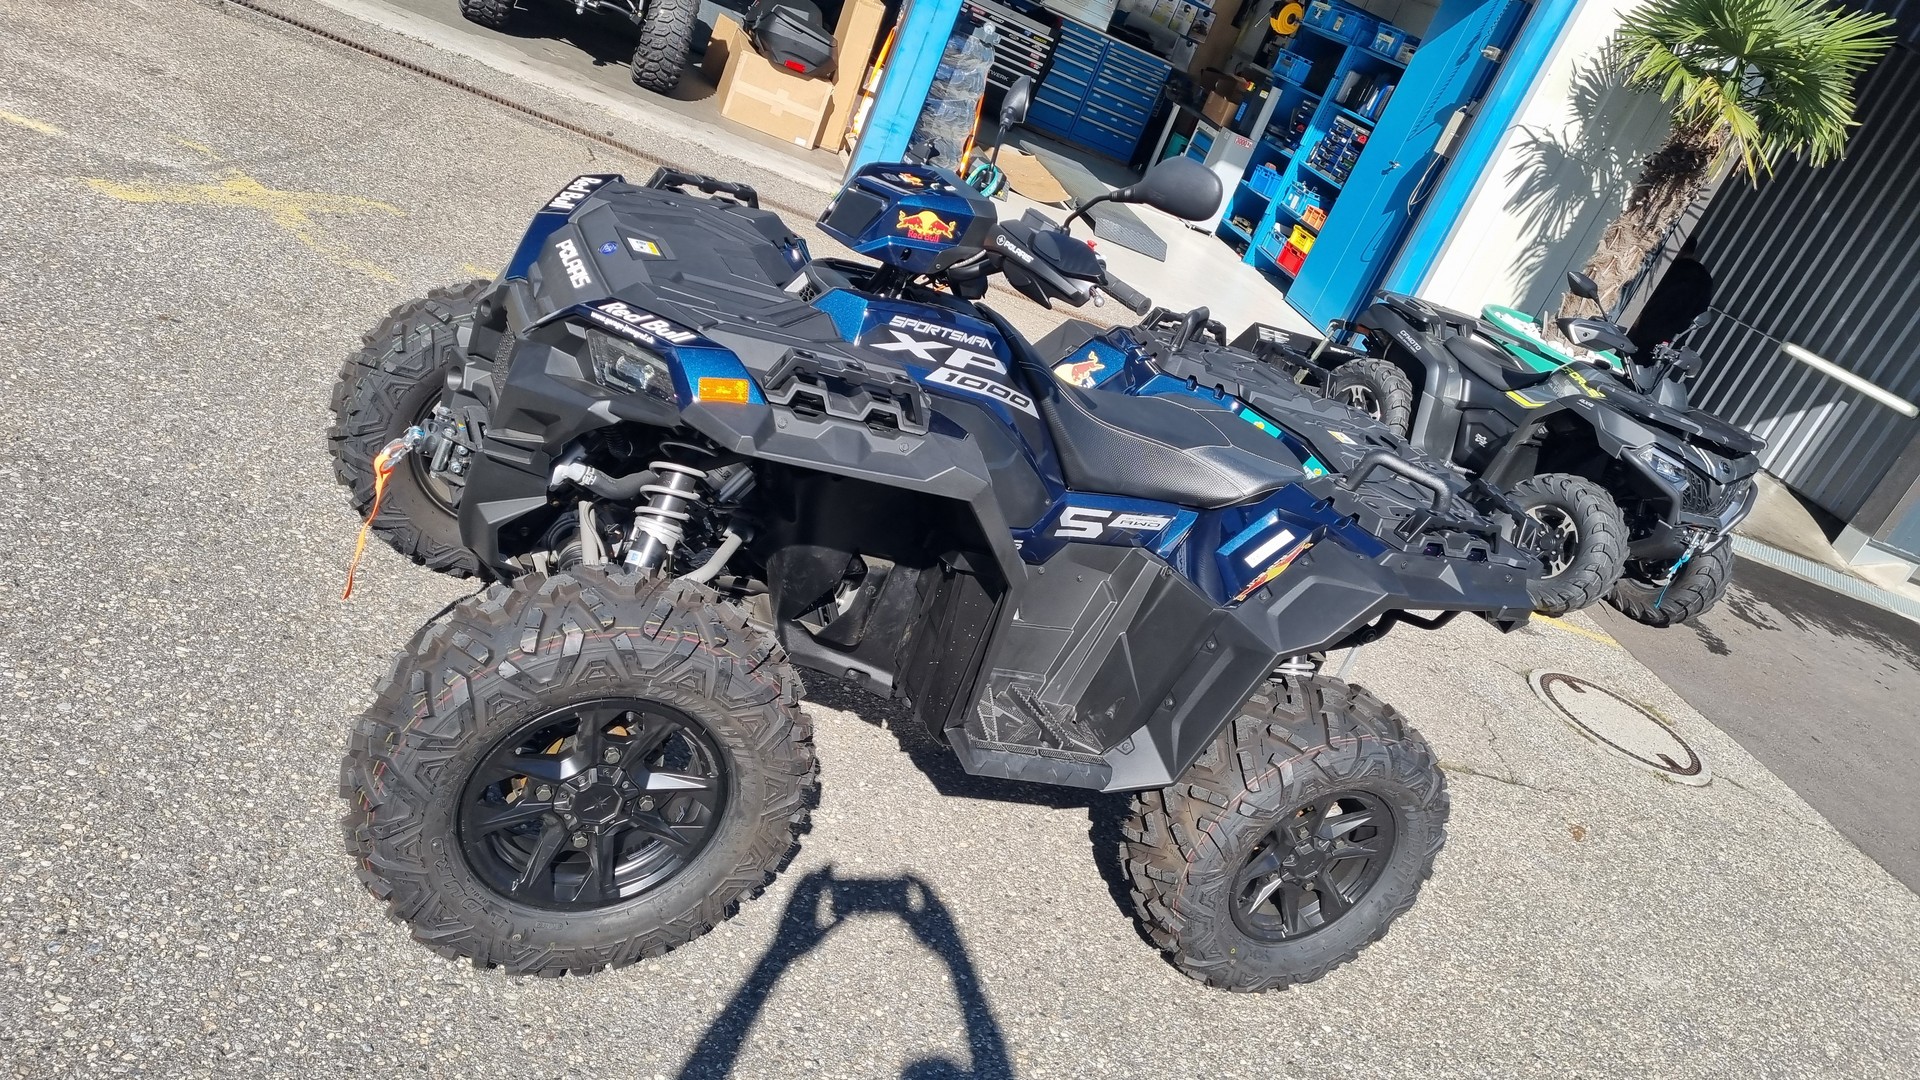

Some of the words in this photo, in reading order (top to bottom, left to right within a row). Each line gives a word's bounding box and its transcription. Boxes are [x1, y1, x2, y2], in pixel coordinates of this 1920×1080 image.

[573, 175, 603, 194] Red
[549, 190, 584, 210] Bull
[907, 229, 925, 239] Red
[923, 231, 941, 243] Bull
[556, 238, 591, 290] POLARIS
[1004, 239, 1035, 264] POLARIS
[597, 301, 654, 324] Red
[639, 318, 697, 344] Bull
[890, 315, 996, 351] SPORTSMAN
[869, 330, 1008, 376] XP
[1400, 330, 1422, 351] CFMOTO
[945, 372, 1031, 409] 1000
[1054, 506, 1113, 539] S
[1119, 519, 1162, 530] AWD
